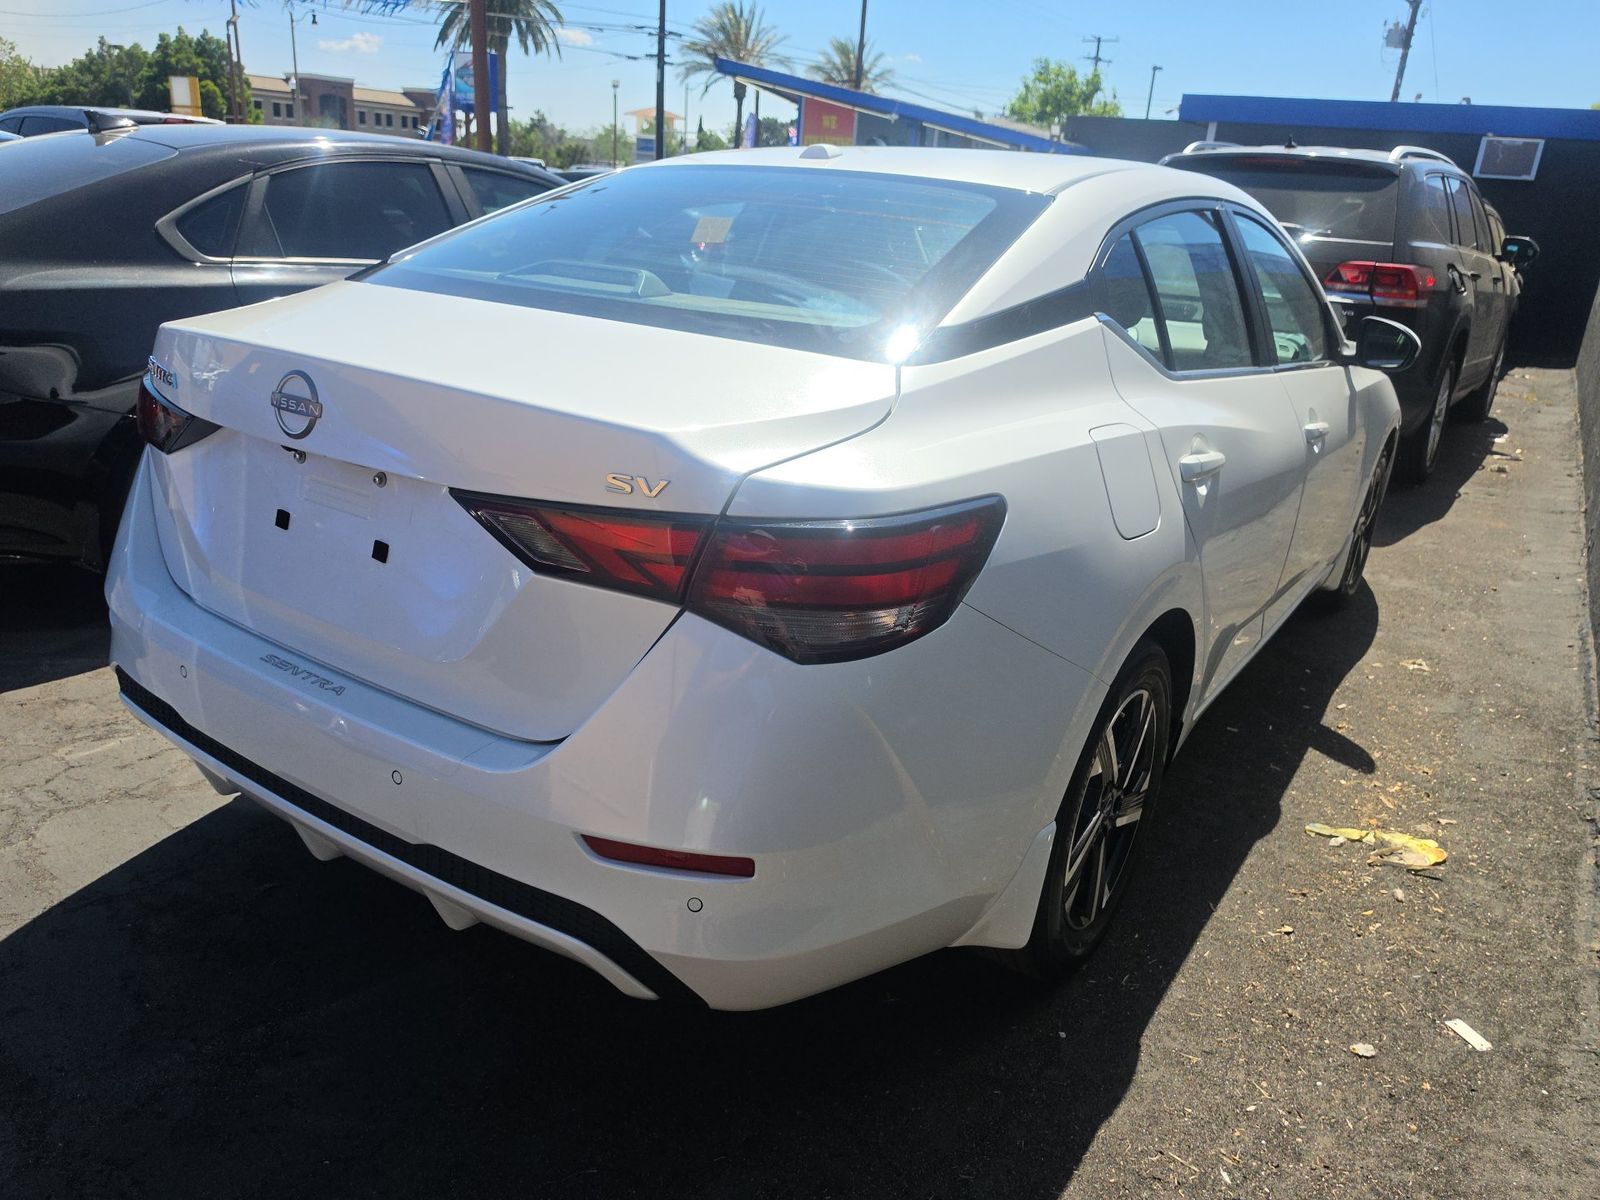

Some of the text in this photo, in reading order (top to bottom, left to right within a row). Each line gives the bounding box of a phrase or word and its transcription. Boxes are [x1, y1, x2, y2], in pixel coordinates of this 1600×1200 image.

[272, 394, 321, 416] NISSAN
[605, 472, 671, 498] SV
[259, 654, 346, 696] SENTRA
